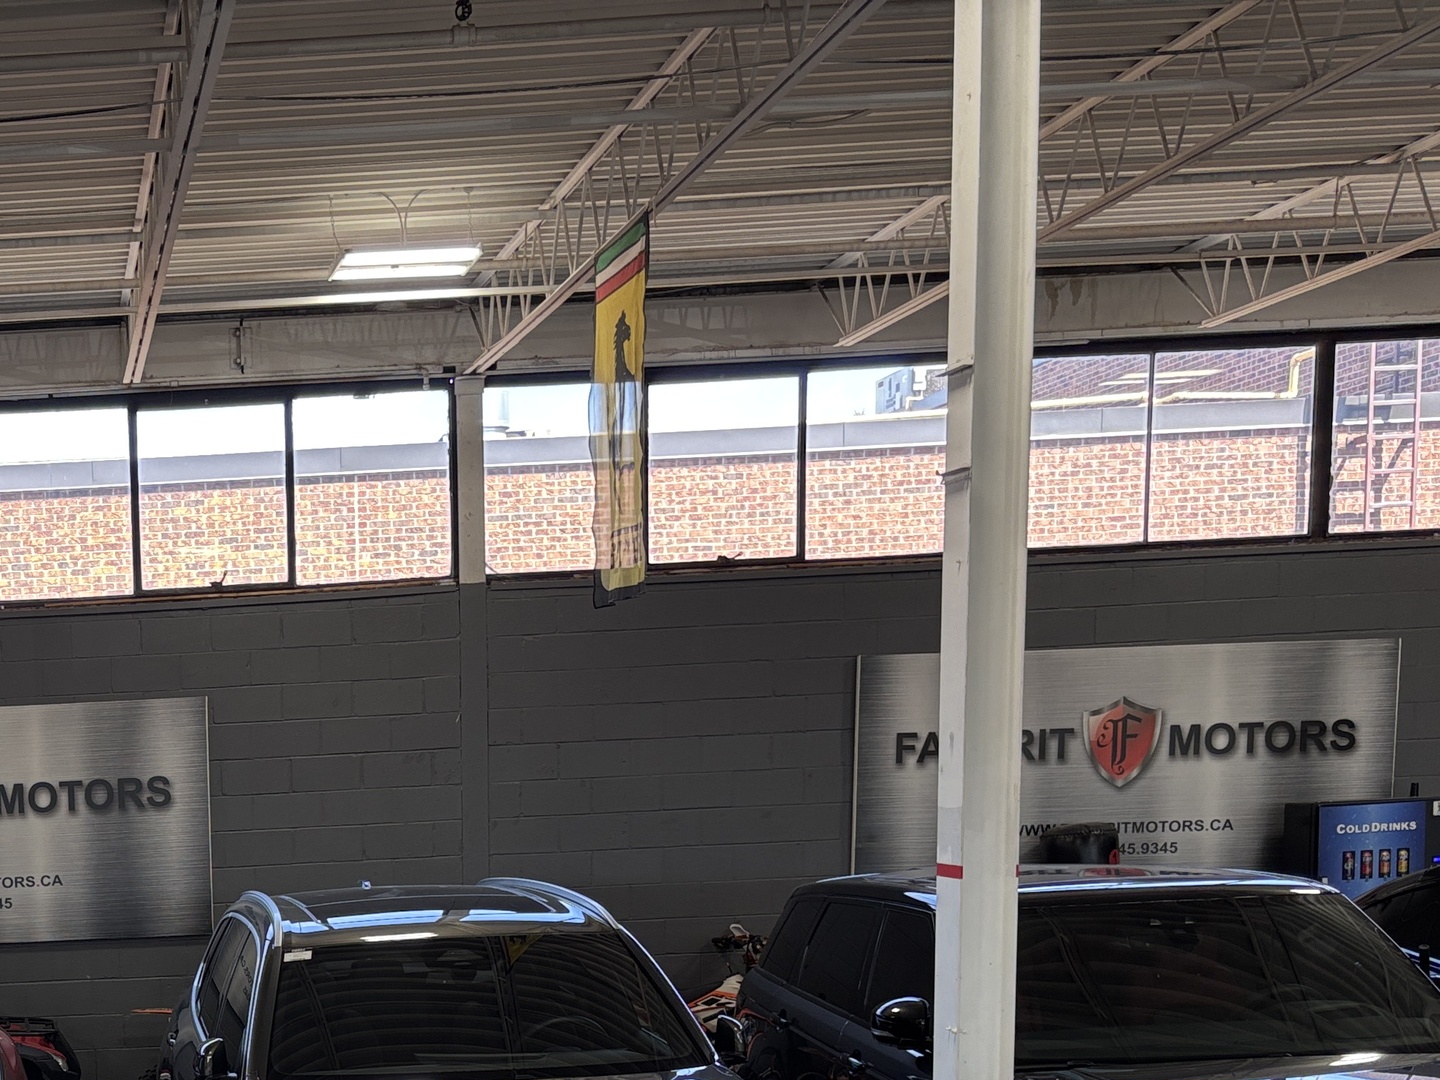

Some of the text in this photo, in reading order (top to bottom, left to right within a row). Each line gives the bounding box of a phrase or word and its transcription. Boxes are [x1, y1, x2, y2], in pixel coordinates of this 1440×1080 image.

[894, 727, 1075, 765] FARIT
[1168, 718, 1357, 757] MOTORS
[1117, 841, 1178, 856] 45.9345
